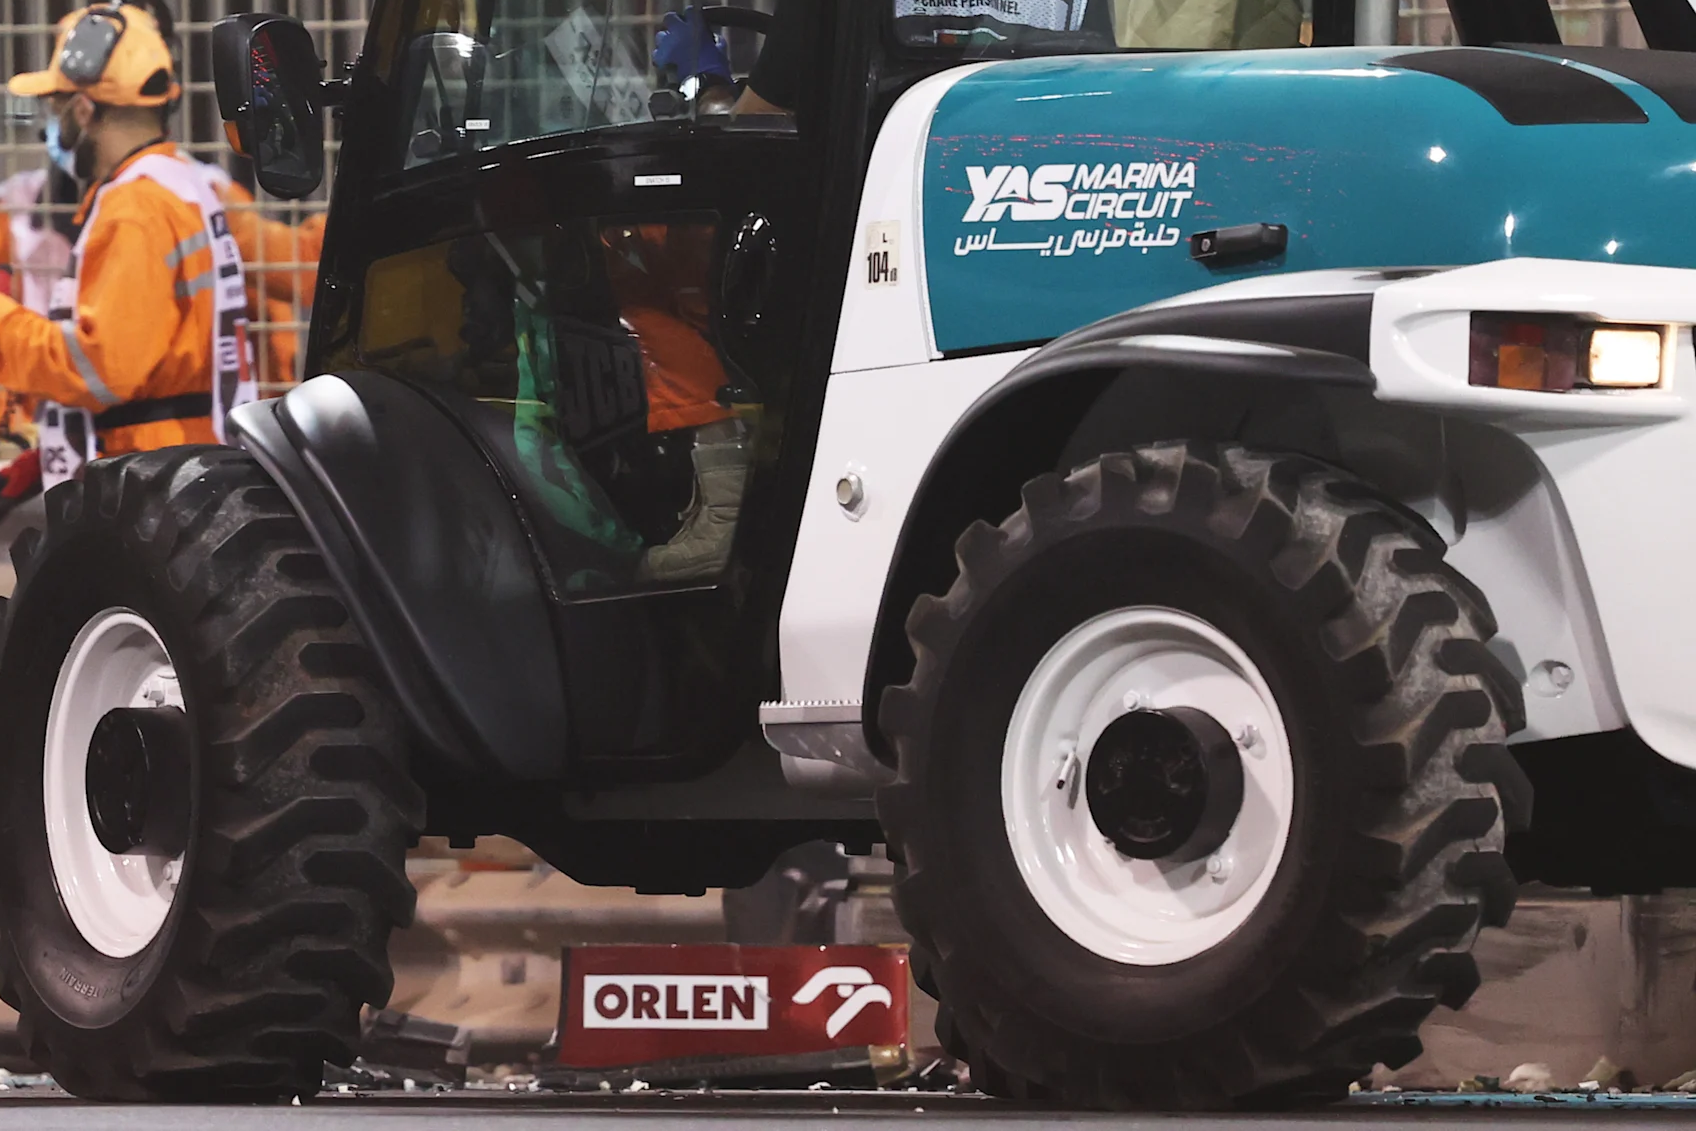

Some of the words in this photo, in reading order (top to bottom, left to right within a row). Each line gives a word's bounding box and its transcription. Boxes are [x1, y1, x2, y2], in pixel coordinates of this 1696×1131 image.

[961, 163, 1076, 222] YAS
[1072, 162, 1195, 190] MARINA
[1065, 191, 1193, 220] CIRCUIT
[1128, 221, 1181, 254] حلبة
[867, 251, 889, 283] 104
[594, 983, 755, 1020] ORLEN
